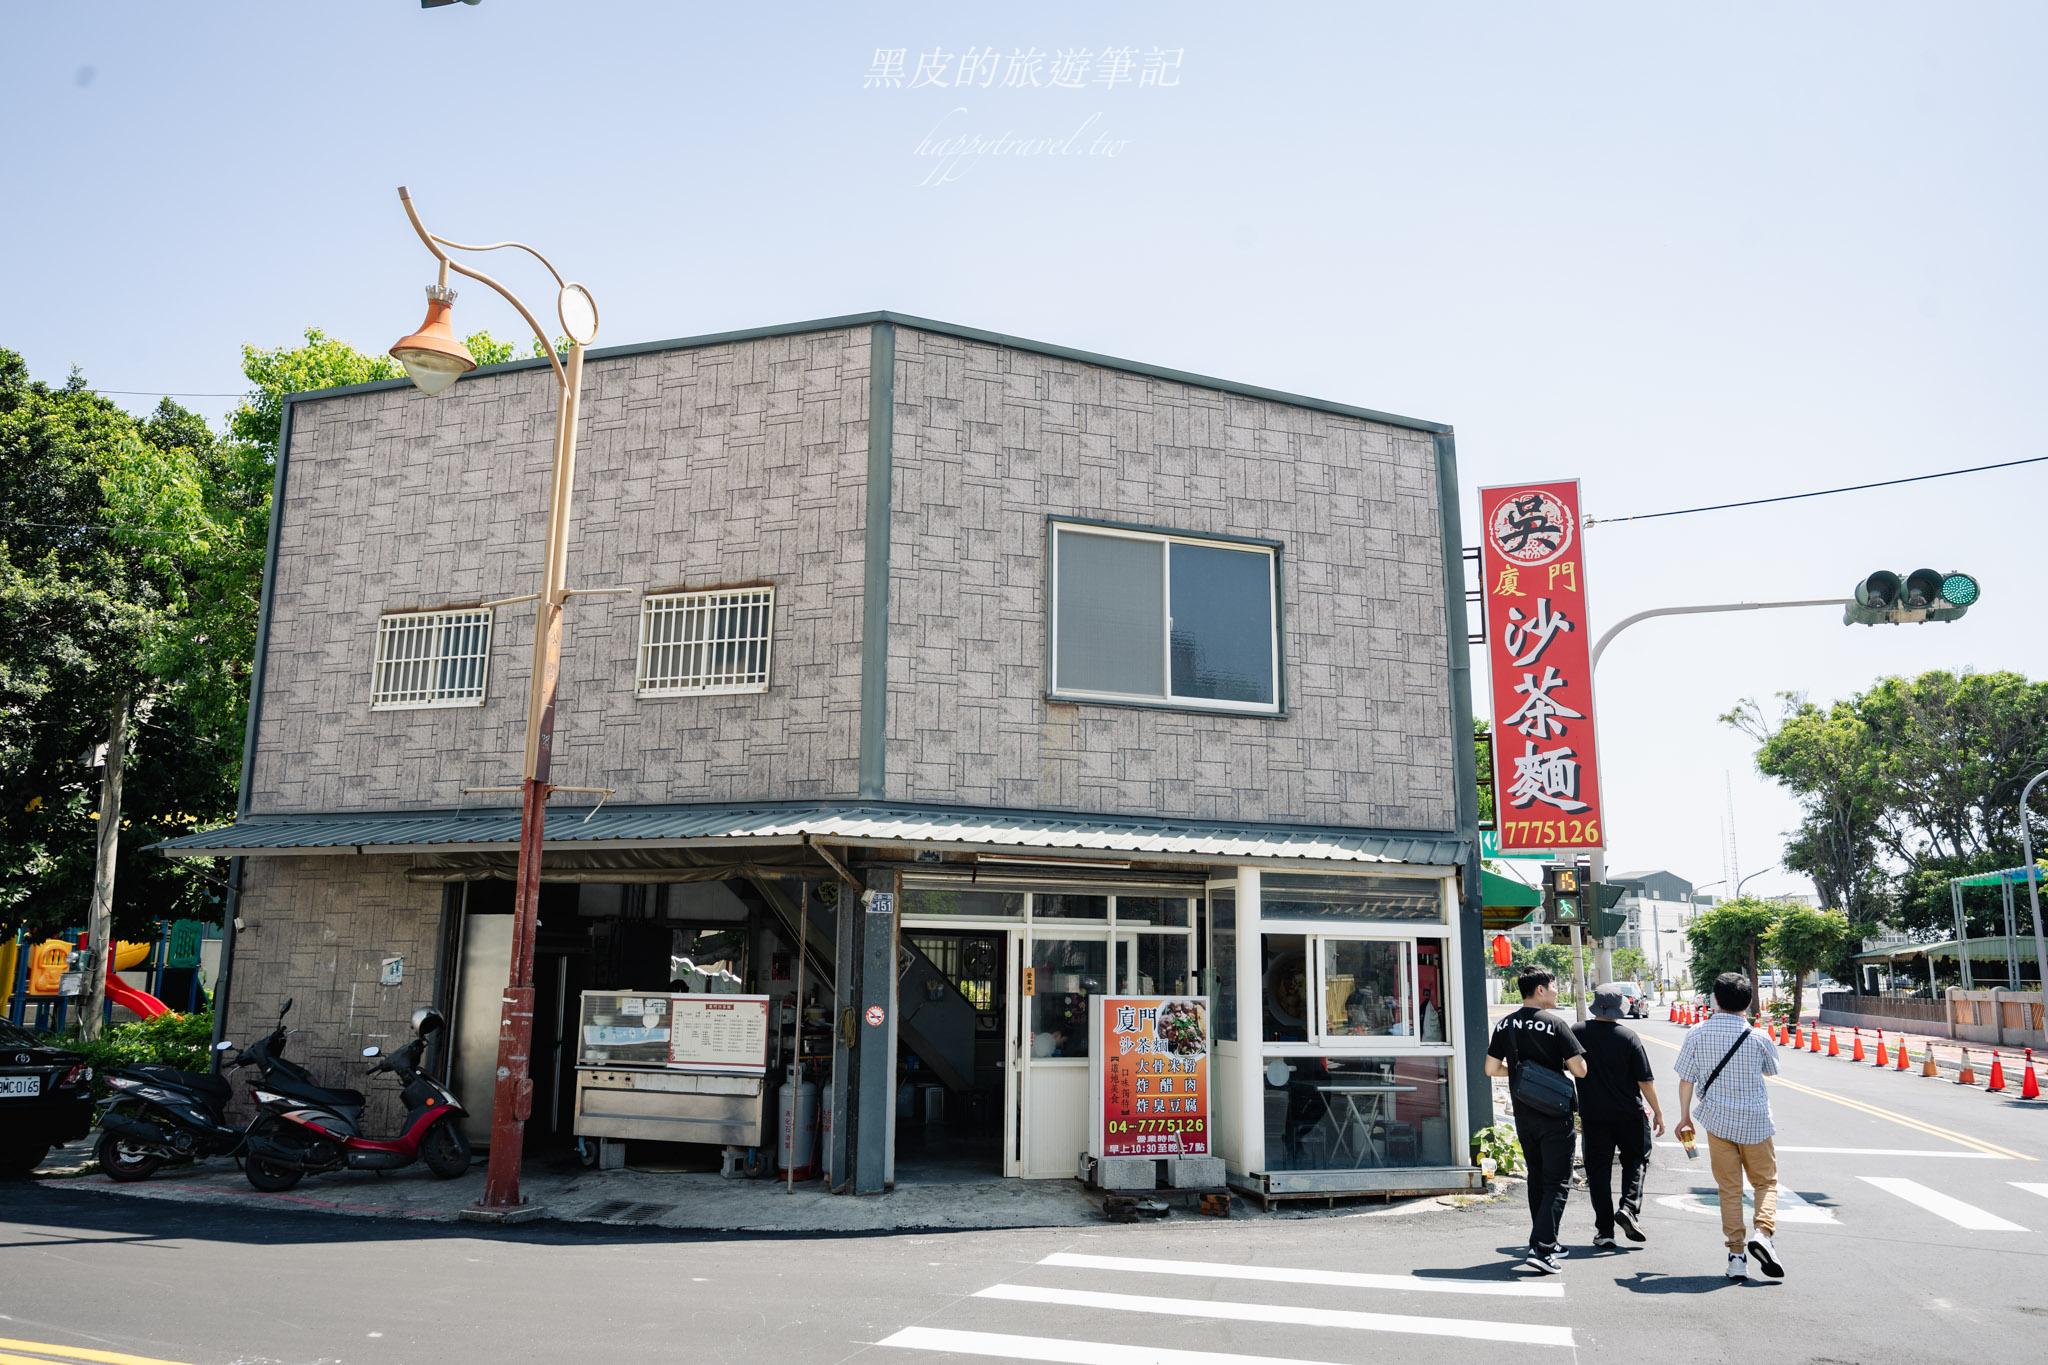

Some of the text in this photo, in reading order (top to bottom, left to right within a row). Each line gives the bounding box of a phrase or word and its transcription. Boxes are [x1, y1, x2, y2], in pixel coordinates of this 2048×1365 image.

[1499, 494, 1562, 554] 吳
[1492, 561, 1577, 597] 廈門
[1502, 597, 1592, 814] 沙茶麵
[1505, 819, 1599, 844] 7775126
[876, 901, 891, 911] 151
[1113, 1006, 1158, 1034] 廈門
[1119, 1037, 1169, 1055] 沙茶麵
[1136, 1058, 1198, 1074] 大骨米粉
[1136, 1078, 1198, 1094] 炸醋肉
[1136, 1098, 1198, 1113] 炸臭豆腐
[1109, 1118, 1204, 1134] 04-7775126
